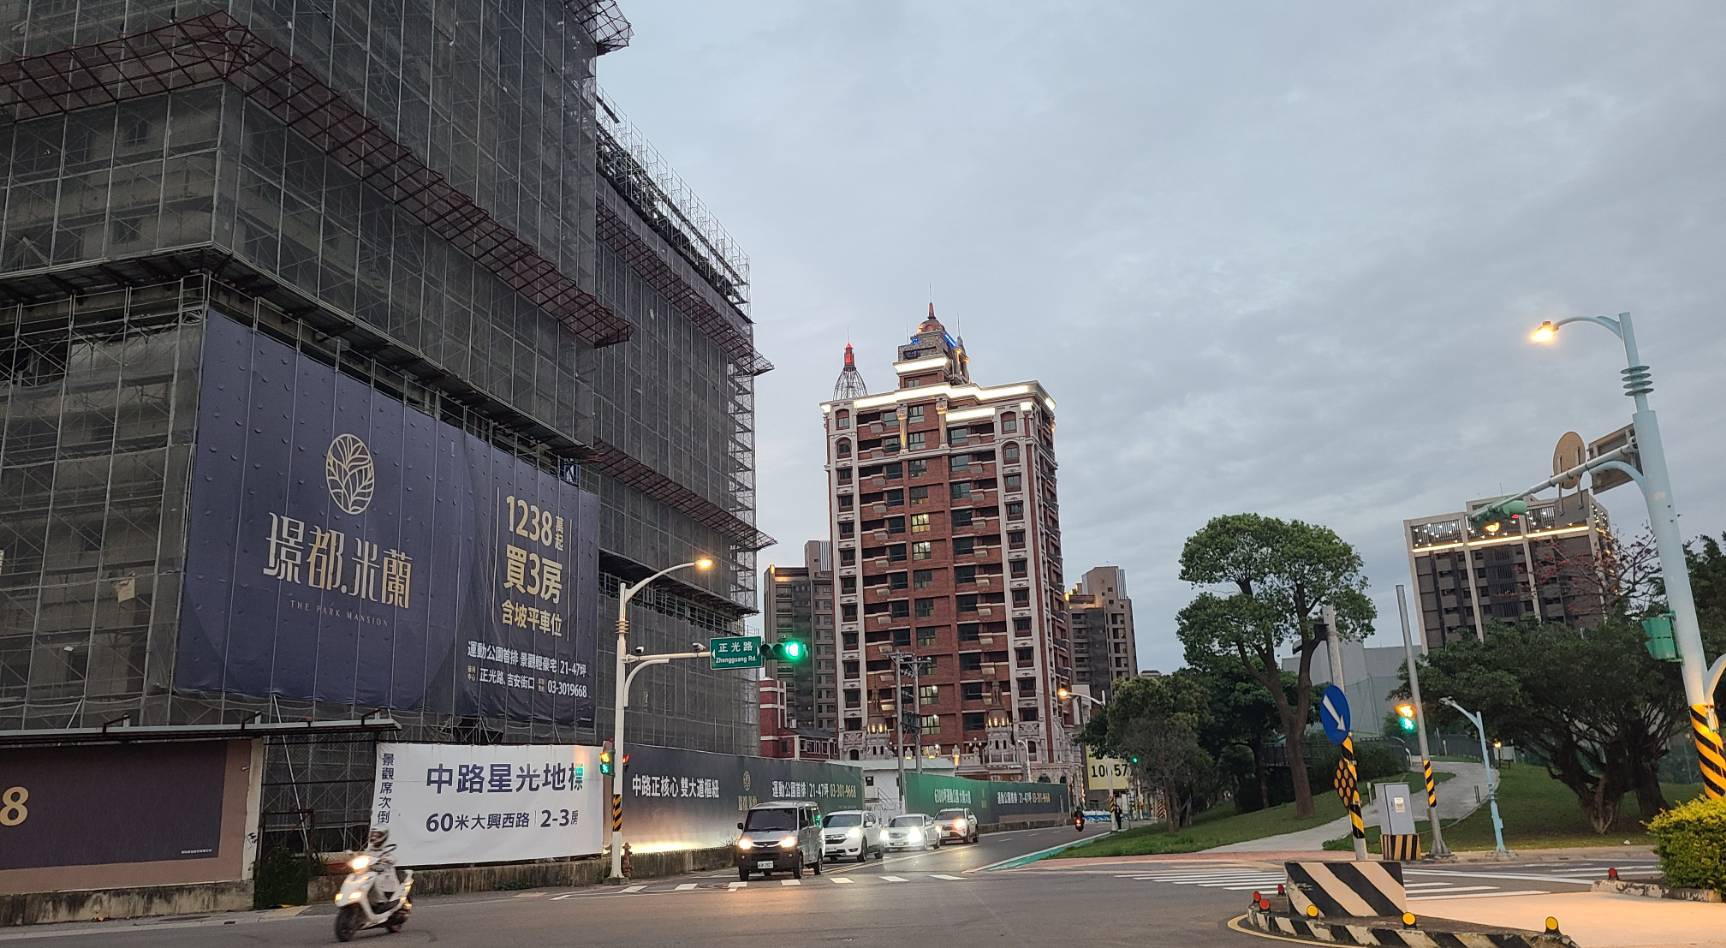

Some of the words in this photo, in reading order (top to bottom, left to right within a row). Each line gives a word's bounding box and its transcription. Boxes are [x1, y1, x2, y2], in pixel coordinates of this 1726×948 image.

[506, 495, 553, 546] 1238
[504, 543, 563, 604] 買3房
[290, 600, 310, 612] THE
[316, 604, 341, 618] PARK
[346, 611, 389, 627] MANSION
[502, 599, 563, 637] 含坡平車位
[718, 641, 753, 653] 正光路
[560, 660, 587, 678] 21-47坪
[547, 680, 588, 698] 03-3019668
[426, 763, 584, 794] 中路星光地標
[632, 774, 679, 797] 中路正核心
[426, 812, 530, 832] 60米大興西路
[540, 809, 579, 828] 2-3房
